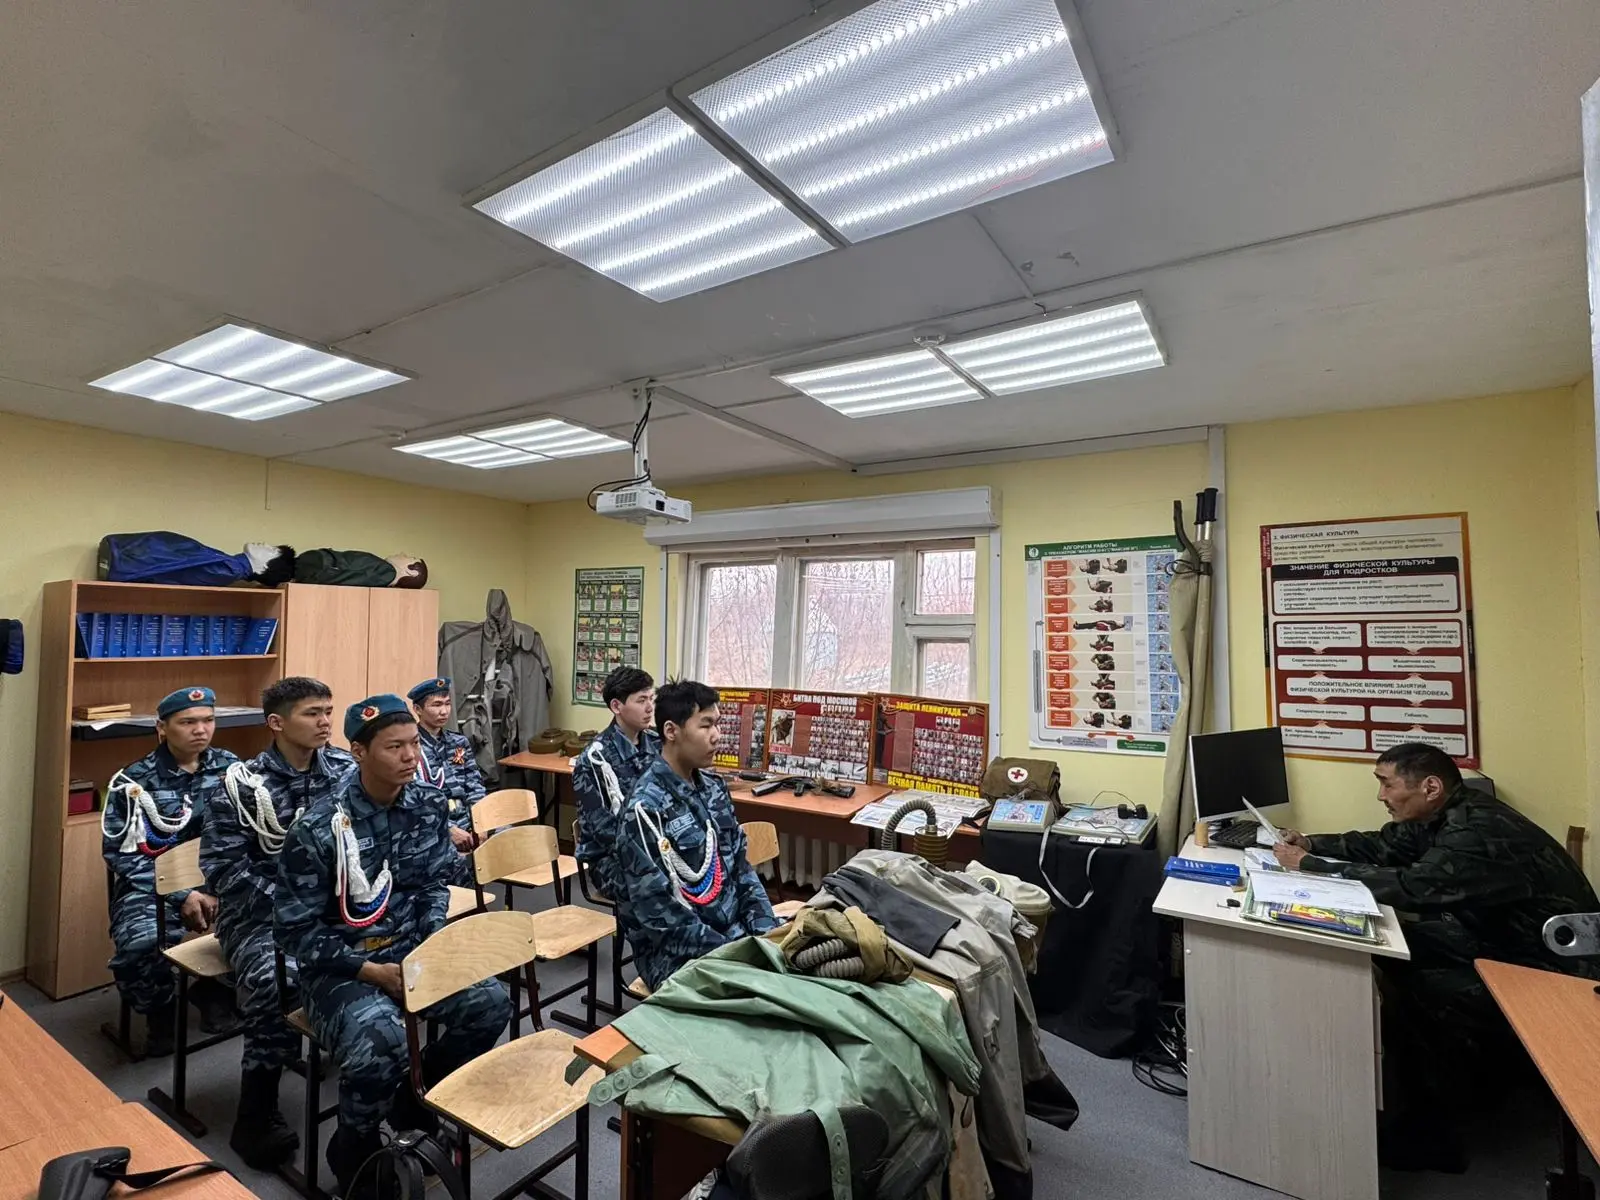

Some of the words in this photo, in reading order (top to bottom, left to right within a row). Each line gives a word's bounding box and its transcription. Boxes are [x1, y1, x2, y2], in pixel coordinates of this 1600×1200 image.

[1280, 531, 1323, 540] ФИЗИЧЕСКАЯ
[1326, 529, 1359, 537] КУЛЬТУРА
[1093, 541, 1118, 549] РАБОТЫ
[1289, 563, 1329, 571] ЗНАЧЕНИЕ
[1333, 560, 1388, 569] ФИЗИЧЕСКОЙ
[1391, 558, 1436, 566] КУЛЬТУРЫ
[1343, 566, 1398, 575] ПОДРОСТКОВ
[793, 694, 812, 703] БИТВА
[812, 695, 826, 705] ПОД
[826, 696, 857, 706] МОСКВОЙ
[896, 701, 920, 711] ЗАЩИТА
[921, 704, 962, 717] ЛЕНИНГРАДА
[887, 775, 915, 788] ВЕЧНАЯ
[915, 781, 946, 794] ПАМЯТЬ
